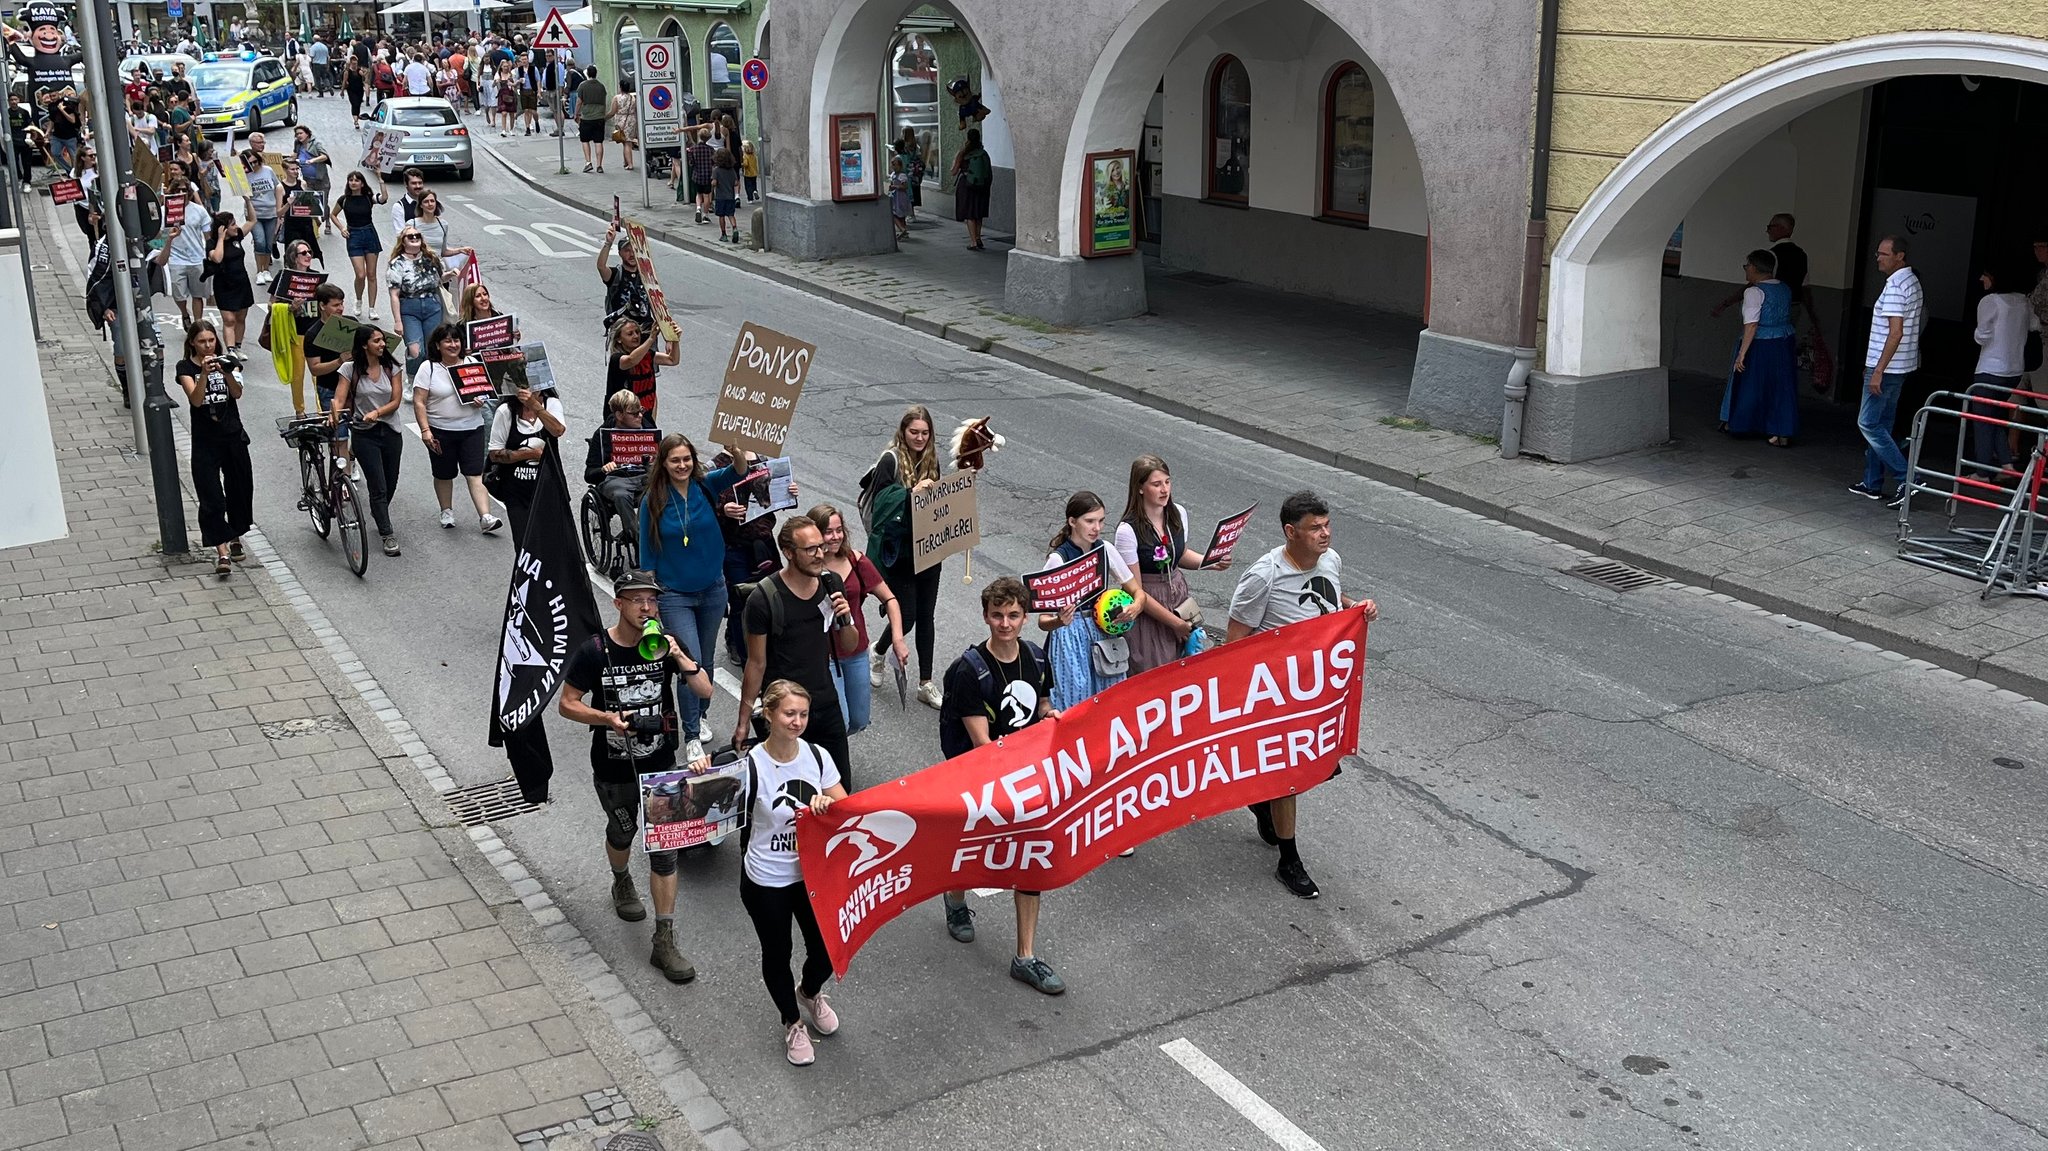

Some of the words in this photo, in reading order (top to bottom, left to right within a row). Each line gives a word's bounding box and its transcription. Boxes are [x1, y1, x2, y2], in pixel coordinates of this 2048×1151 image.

[31, 7, 57, 16] KAYA
[651, 52, 664, 63] 20
[478, 330, 506, 339] sensible
[732, 331, 809, 385] PONYS
[724, 383, 747, 401] RAUS
[748, 390, 766, 405] AUS
[611, 434, 655, 442] Rosenheim
[638, 444, 656, 452] dein
[933, 504, 950, 522] SIND
[1218, 519, 1244, 534] Ponys
[1032, 556, 1099, 587] Artgerecht
[1059, 581, 1077, 593] nur
[1078, 572, 1094, 584] die
[1034, 577, 1102, 609] FREIHEIT
[960, 736, 1093, 833] KEIN
[1104, 638, 1357, 774] APPLAUS
[646, 834, 659, 844] ist
[659, 829, 688, 842] KEINE
[688, 824, 717, 837] Kinder-
[655, 818, 706, 834] Tierquälerei
[950, 837, 1055, 874] FÜR
[838, 863, 913, 928] ANIMALS
[839, 876, 912, 944] UNITED
